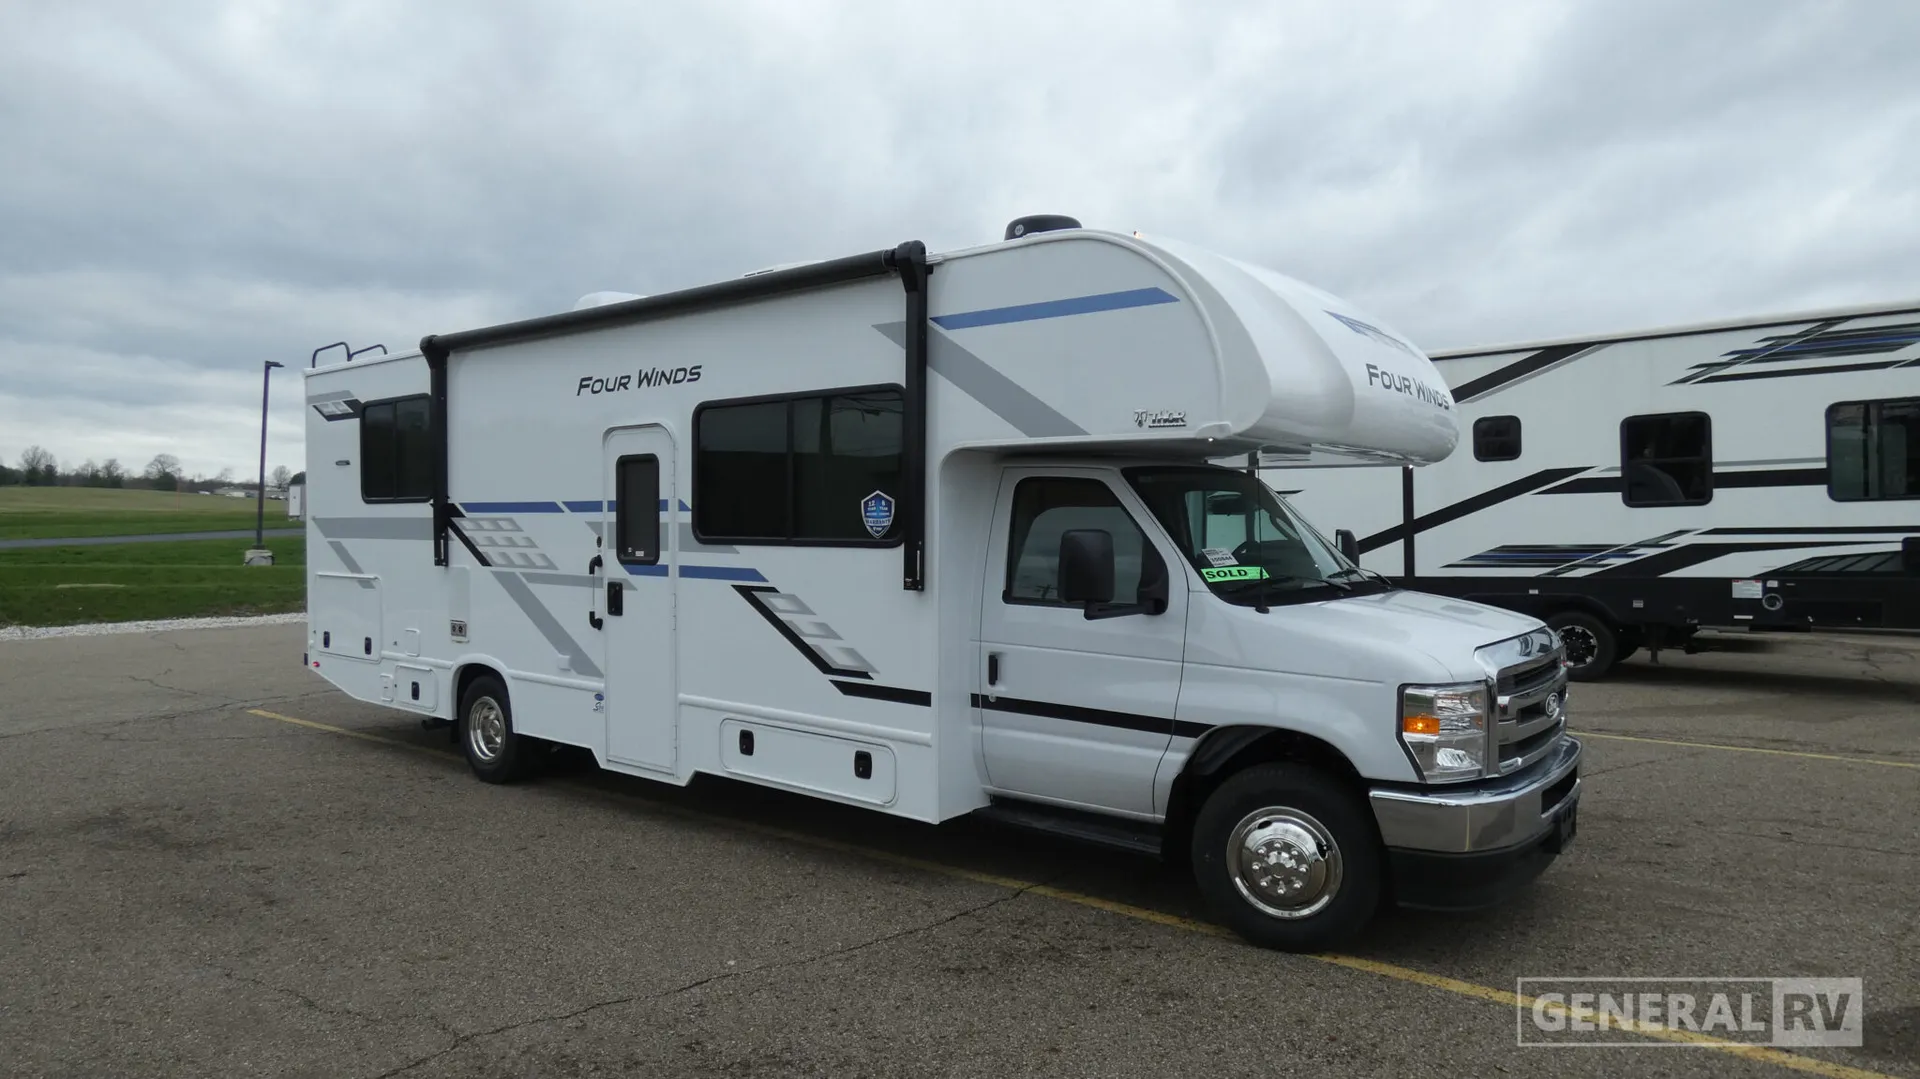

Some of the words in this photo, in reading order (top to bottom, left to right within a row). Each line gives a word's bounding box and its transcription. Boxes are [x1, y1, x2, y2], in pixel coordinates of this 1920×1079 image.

[577, 375, 631, 396] FOUR
[638, 365, 702, 389] WINDS
[1366, 363, 1413, 396] FOUR
[1412, 377, 1450, 410] WINDS
[1205, 569, 1248, 579] SOLD
